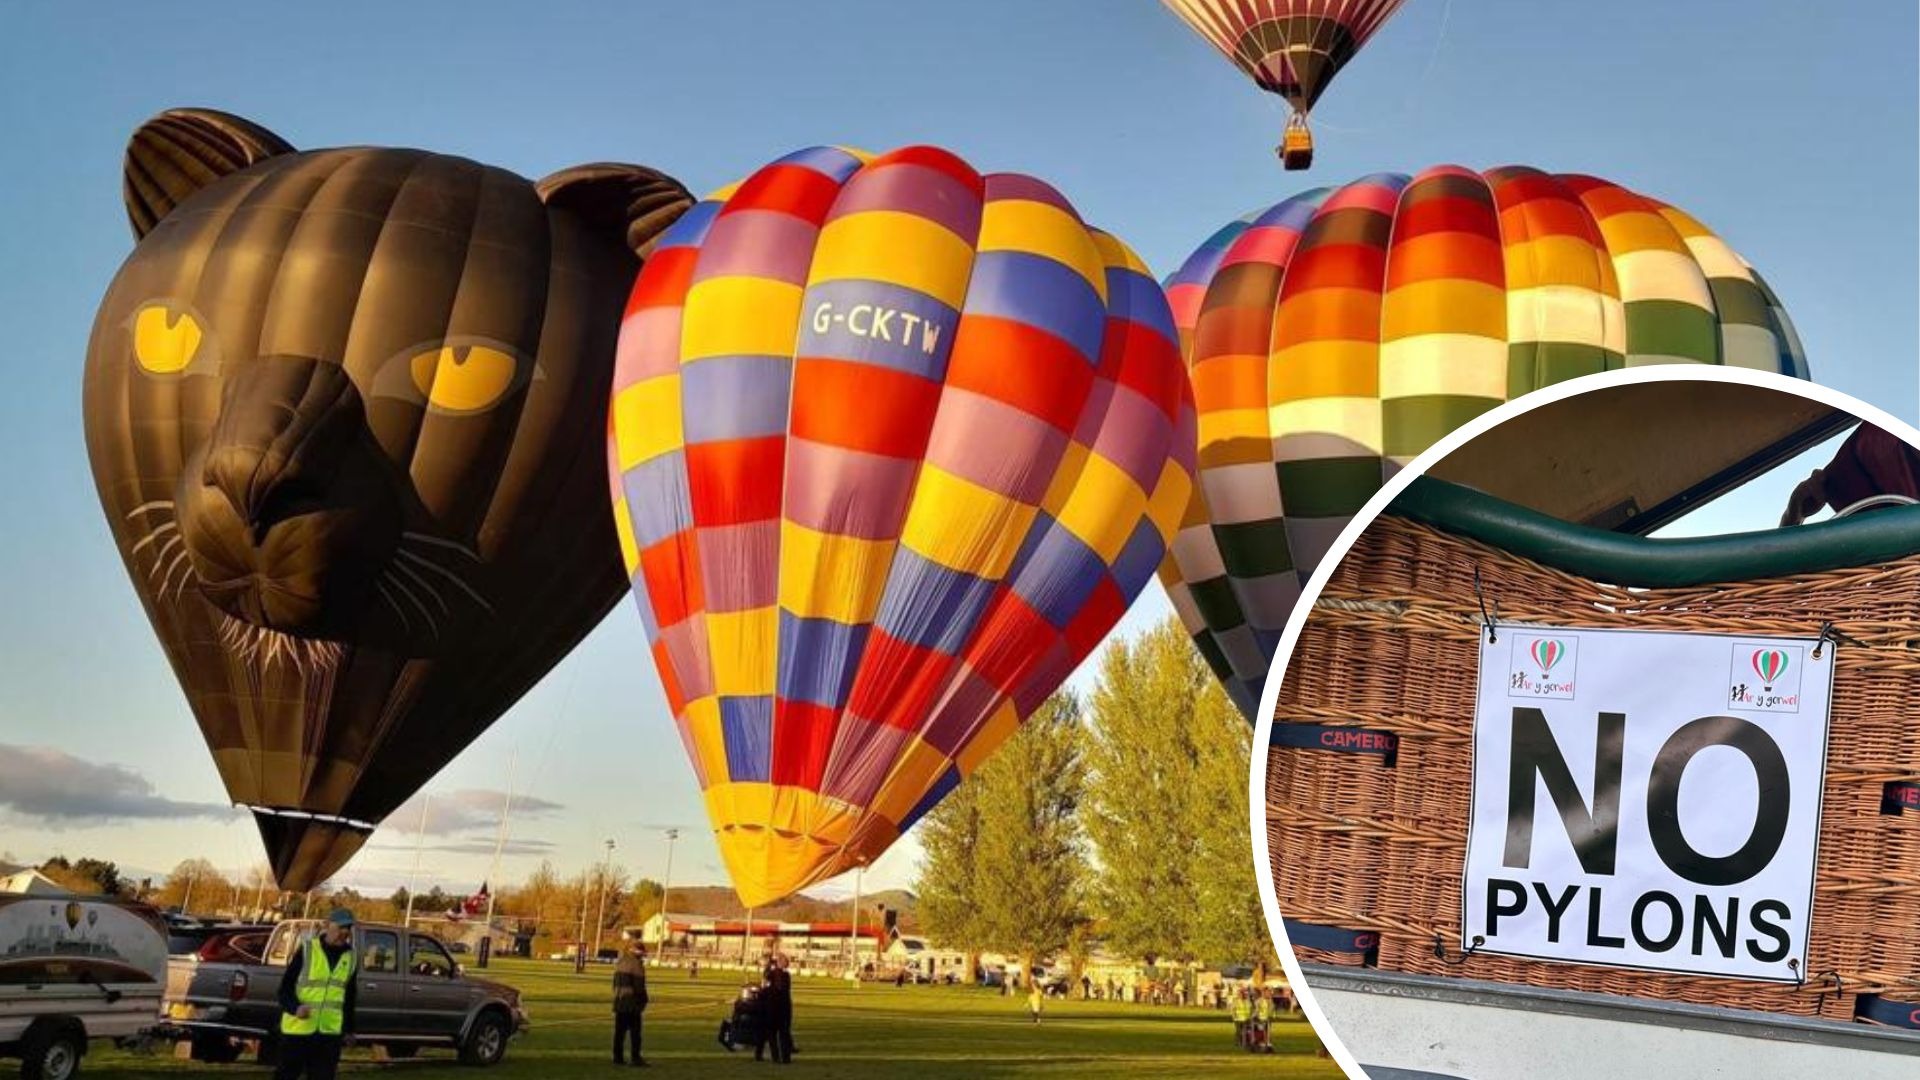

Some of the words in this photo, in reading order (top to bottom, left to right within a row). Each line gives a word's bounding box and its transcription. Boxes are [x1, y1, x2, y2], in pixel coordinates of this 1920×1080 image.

[813, 301, 940, 355] G-CKTW
[1535, 682, 1542, 694] y
[1756, 695, 1764, 707] y
[1502, 707, 1790, 887] NO
[1486, 879, 1792, 964] PYLONS
